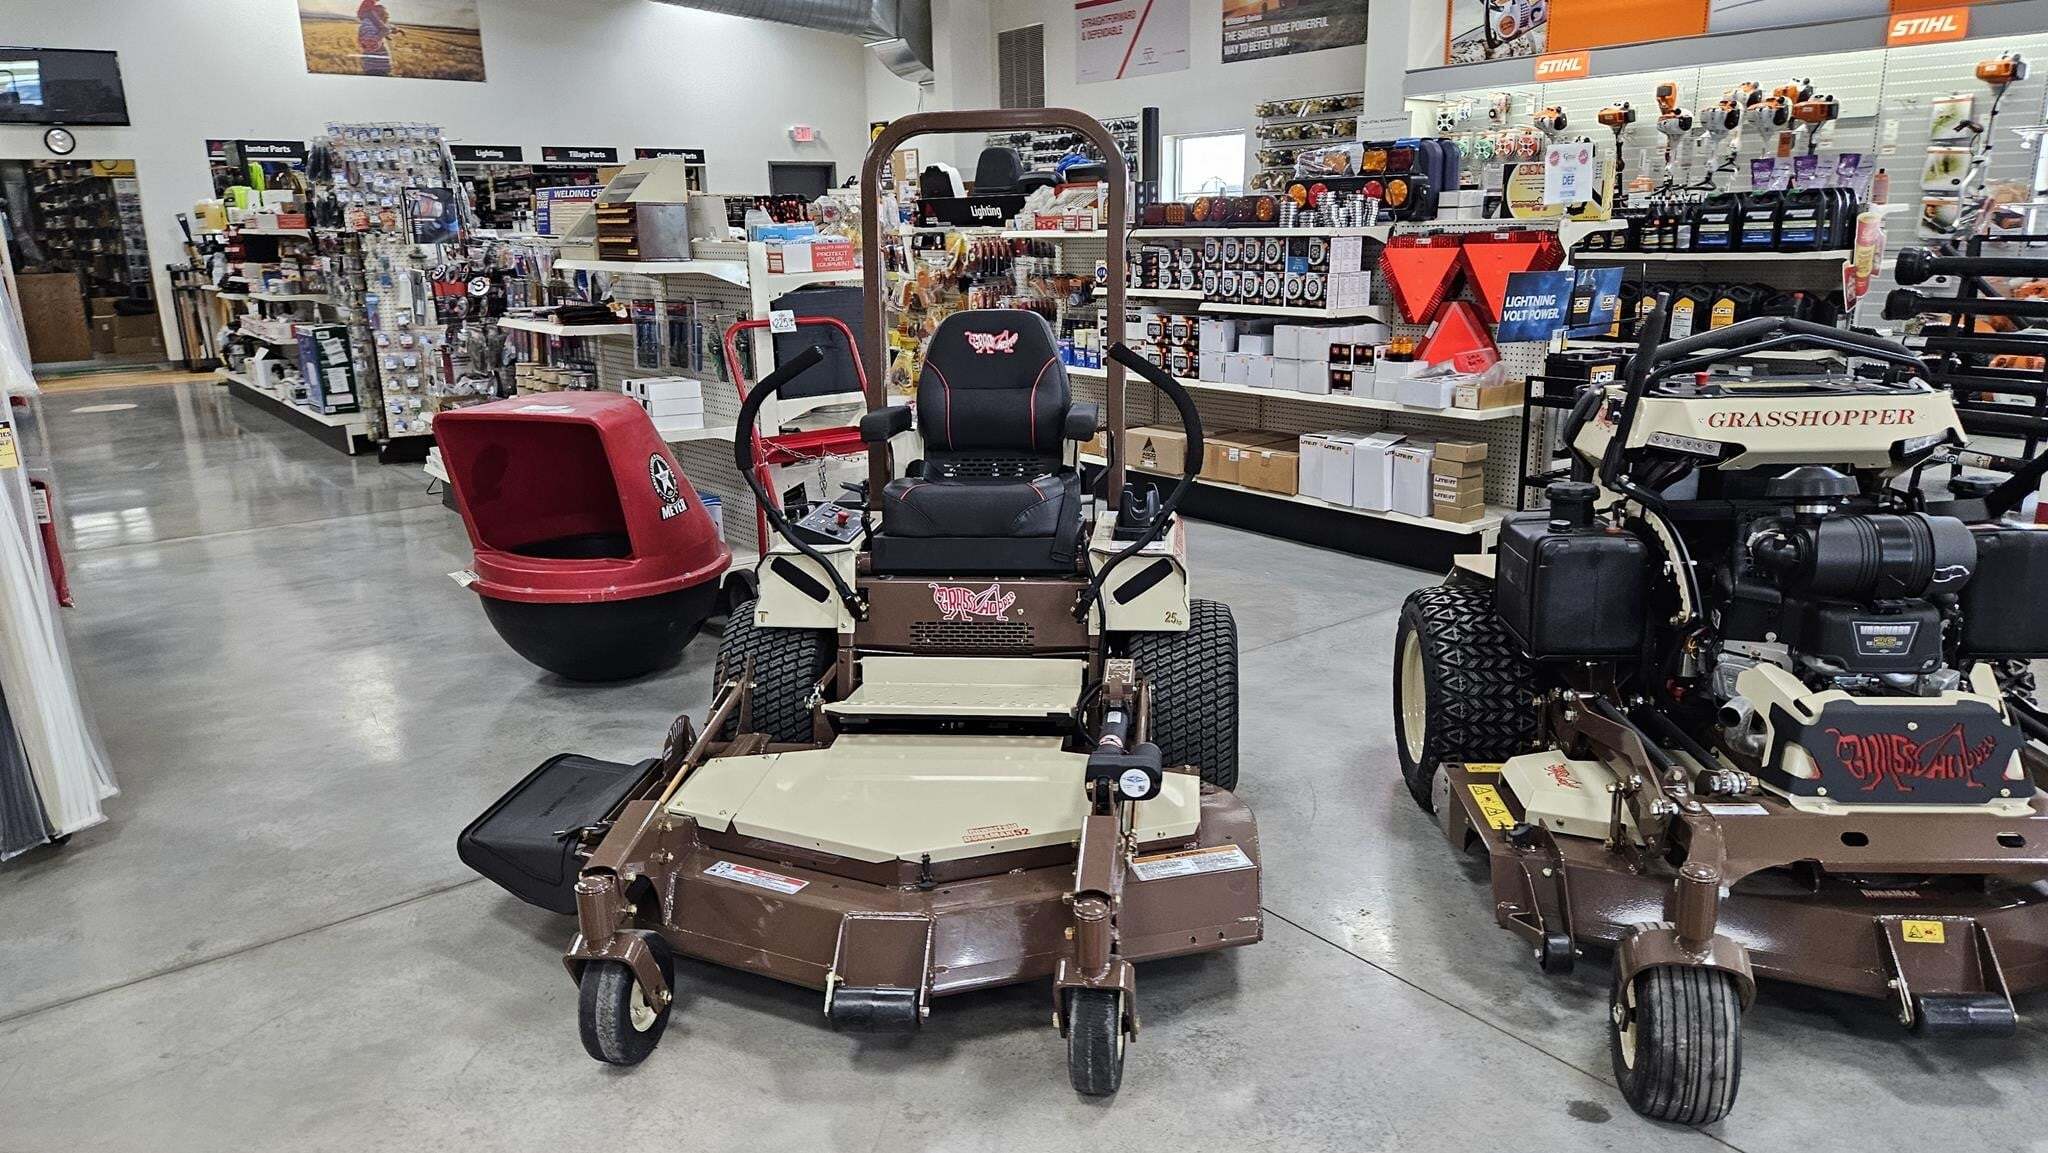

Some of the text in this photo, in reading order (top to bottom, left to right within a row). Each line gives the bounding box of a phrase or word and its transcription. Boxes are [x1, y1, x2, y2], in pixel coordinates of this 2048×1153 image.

[1081, 10, 1137, 29] STRAIGHTFORWARD
[1890, 15, 1958, 37] STIHL
[1087, 25, 1124, 40] DEPENDABLE
[1225, 16, 1329, 42] THE SMARTER, MORE POWERFUL
[1224, 37, 1291, 55] WAY TO BETTER HAY.
[1537, 57, 1583, 74] STIHL
[244, 145, 291, 153] lanter Parts
[475, 150, 504, 159] Lighting
[568, 151, 590, 159] Tillage
[682, 152, 697, 160] Parts
[1562, 175, 1575, 186] DEF
[554, 189, 590, 199] WELDING
[970, 204, 1002, 219] Lighting
[1505, 295, 1557, 308] LIGHTNING
[1503, 308, 1560, 322] VOLT POWER.
[1591, 371, 1613, 384] JCB
[1708, 408, 1916, 428] GRASSHOPPER
[661, 498, 688, 520] MEYER
[1165, 611, 1178, 624] 25
[1860, 625, 1911, 635] VANGUARD
[1013, 828, 1032, 838] 52
